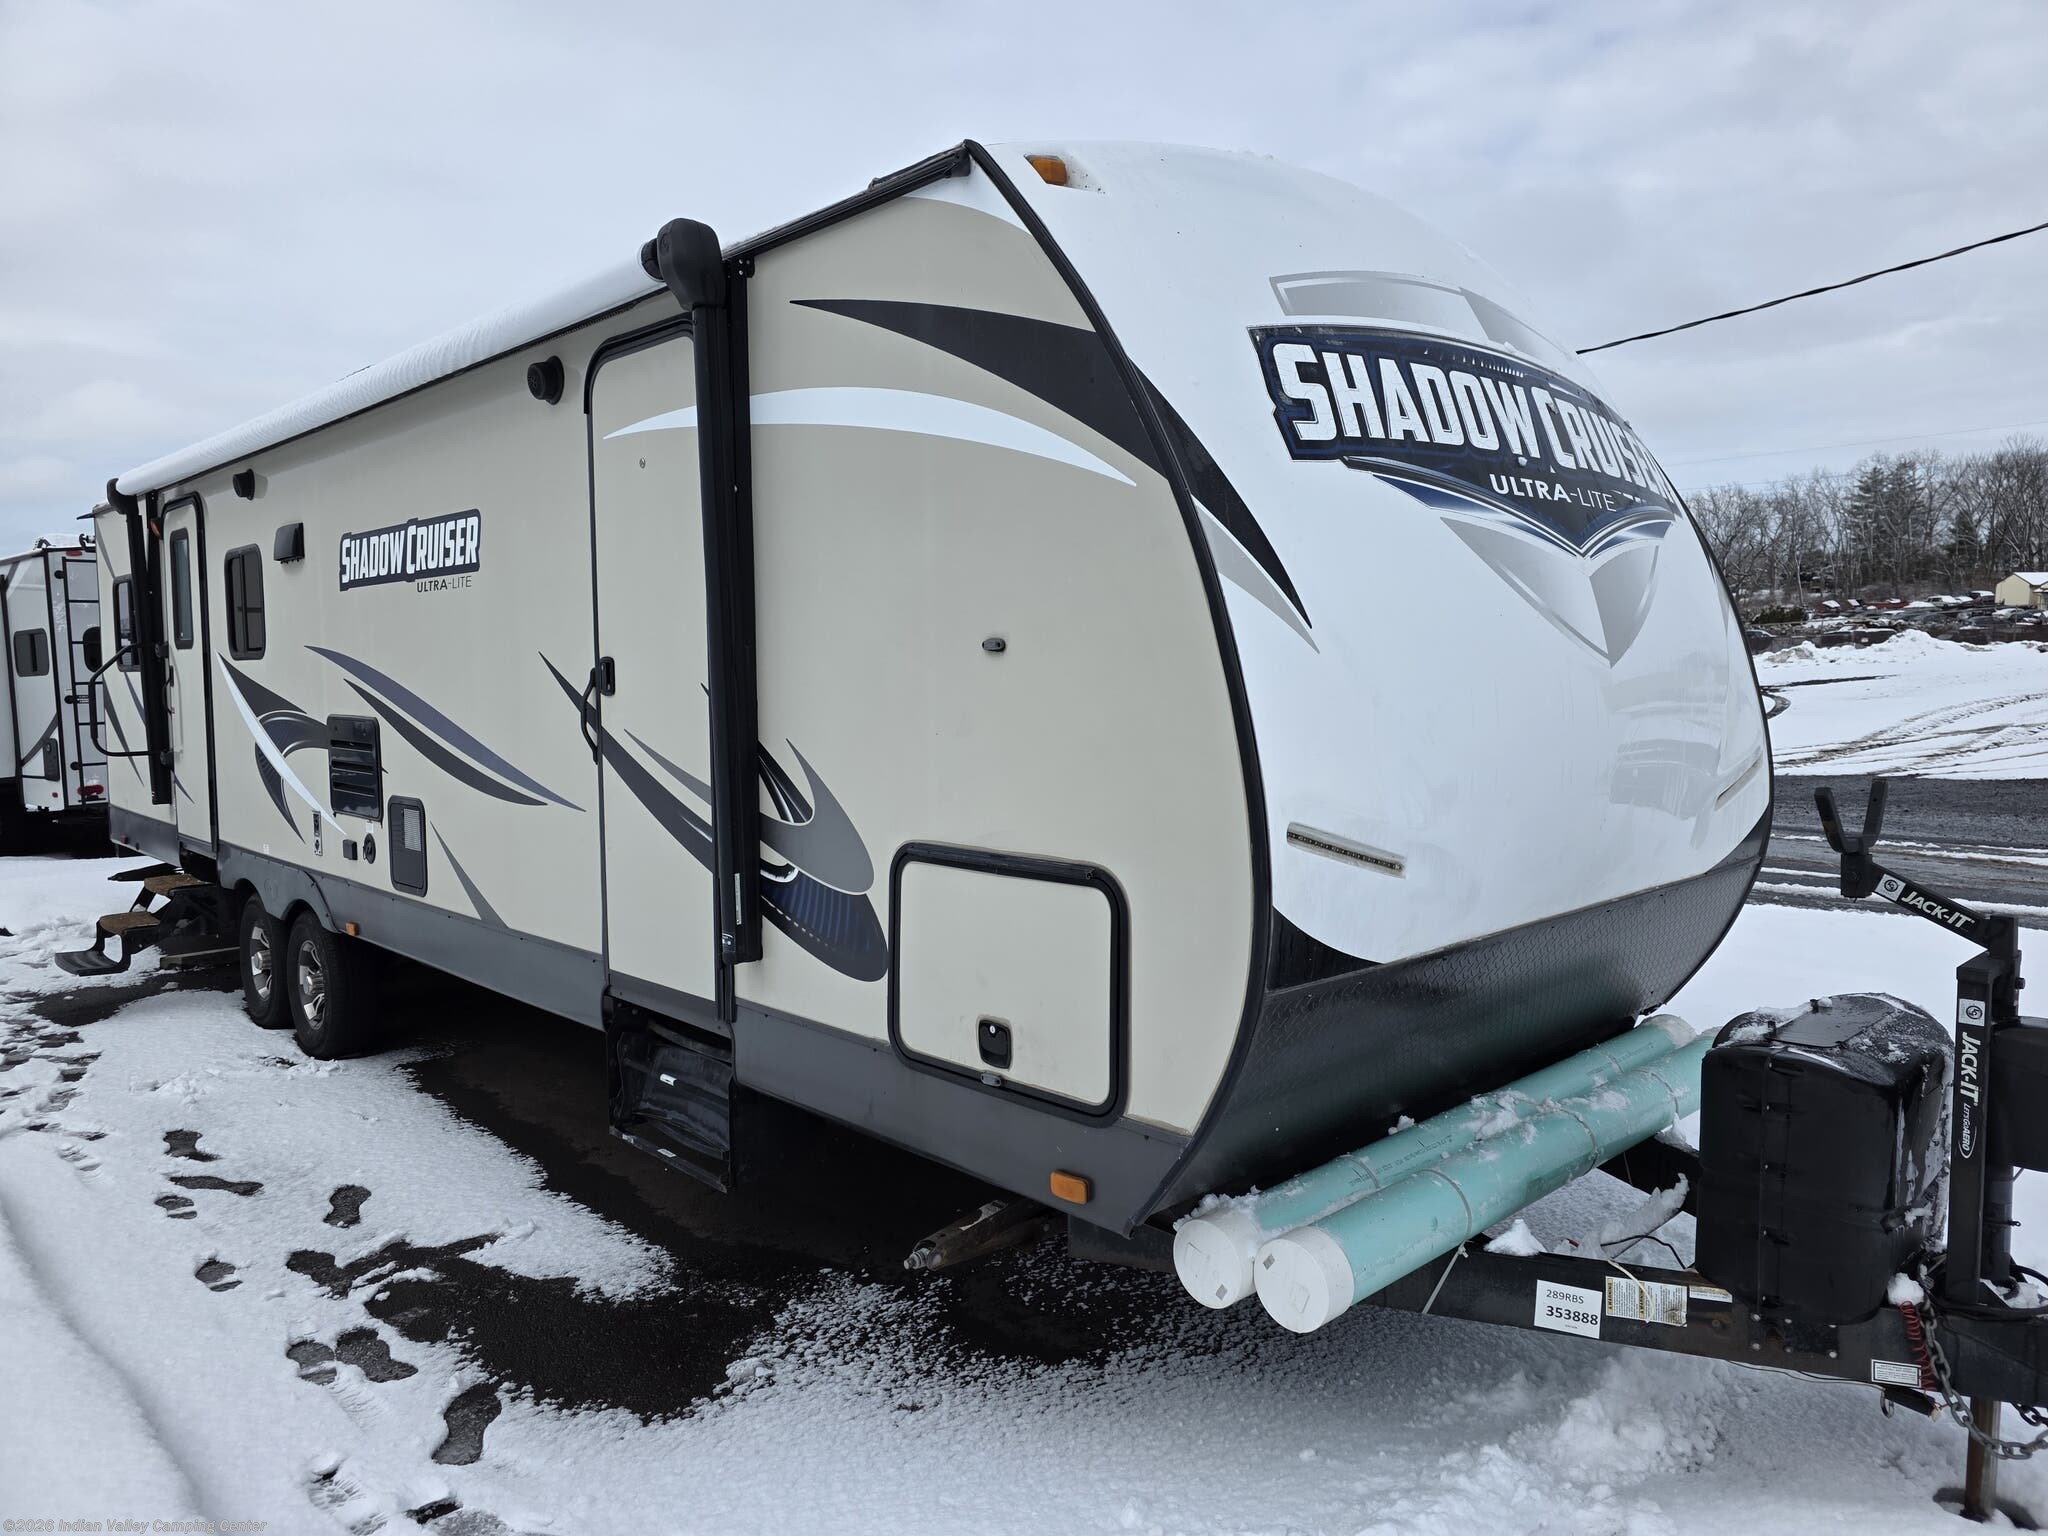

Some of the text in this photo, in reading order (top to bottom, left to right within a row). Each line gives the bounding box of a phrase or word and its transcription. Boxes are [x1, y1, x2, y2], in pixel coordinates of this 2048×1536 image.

[1489, 473, 1617, 512] ULTRA-LITE
[416, 575, 472, 593] ULTRA-LITE
[1901, 891, 1973, 928] JACK-IT
[1960, 1031, 1981, 1103] JACK-IT
[1546, 1289, 1584, 1304] 289RBS
[1545, 1305, 1598, 1326] 353888
